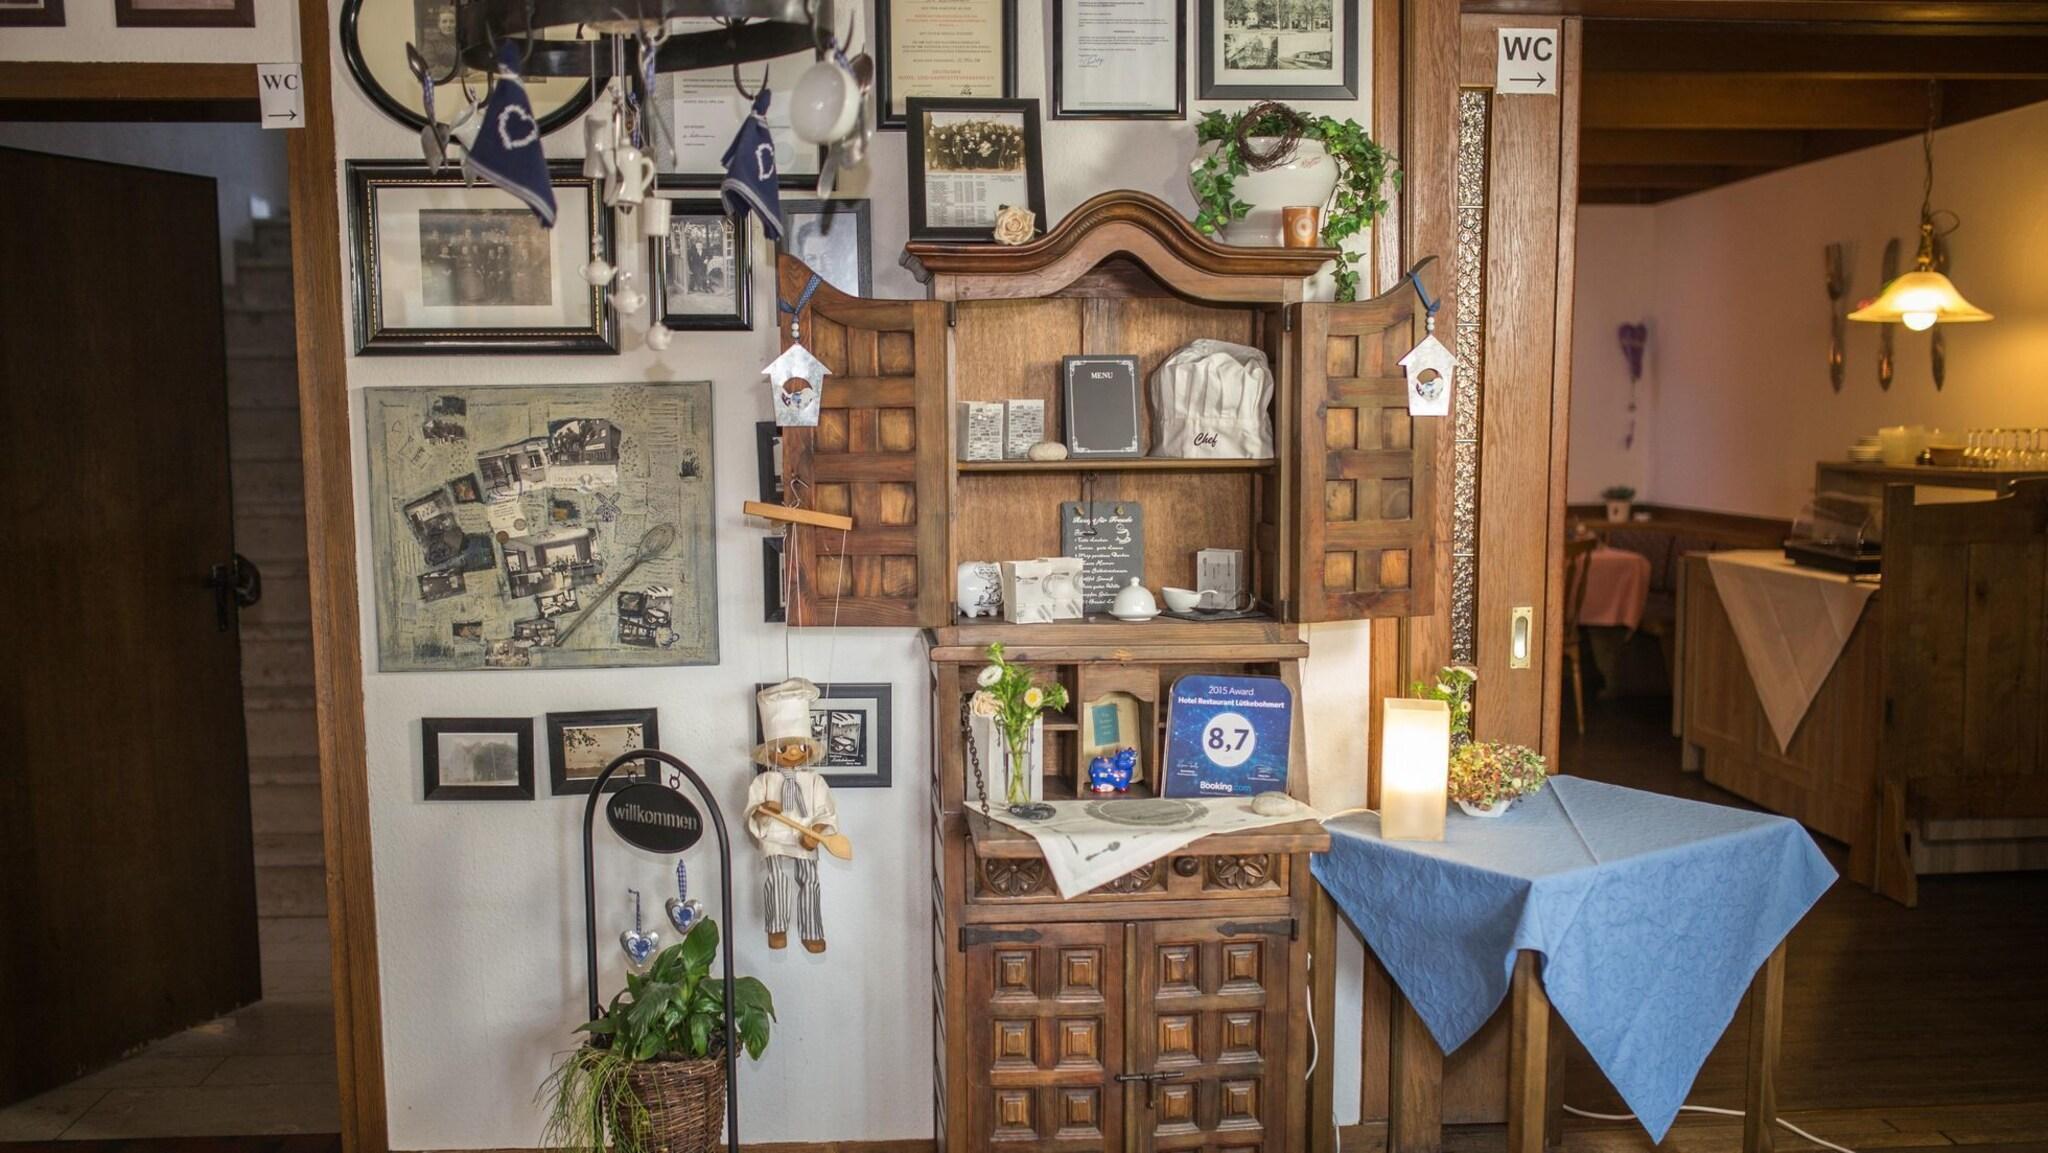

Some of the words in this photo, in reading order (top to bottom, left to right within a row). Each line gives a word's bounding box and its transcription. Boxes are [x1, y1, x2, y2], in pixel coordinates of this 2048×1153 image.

[1503, 36, 1553, 61] WC
[262, 74, 298, 90] WC
[1193, 432, 1218, 447] Chef
[1208, 686, 1227, 695] 2015
[1229, 687, 1254, 696] Award
[1198, 698, 1234, 706] Restaurant
[1208, 727, 1249, 752] 8,7
[614, 804, 697, 830] willkommen
